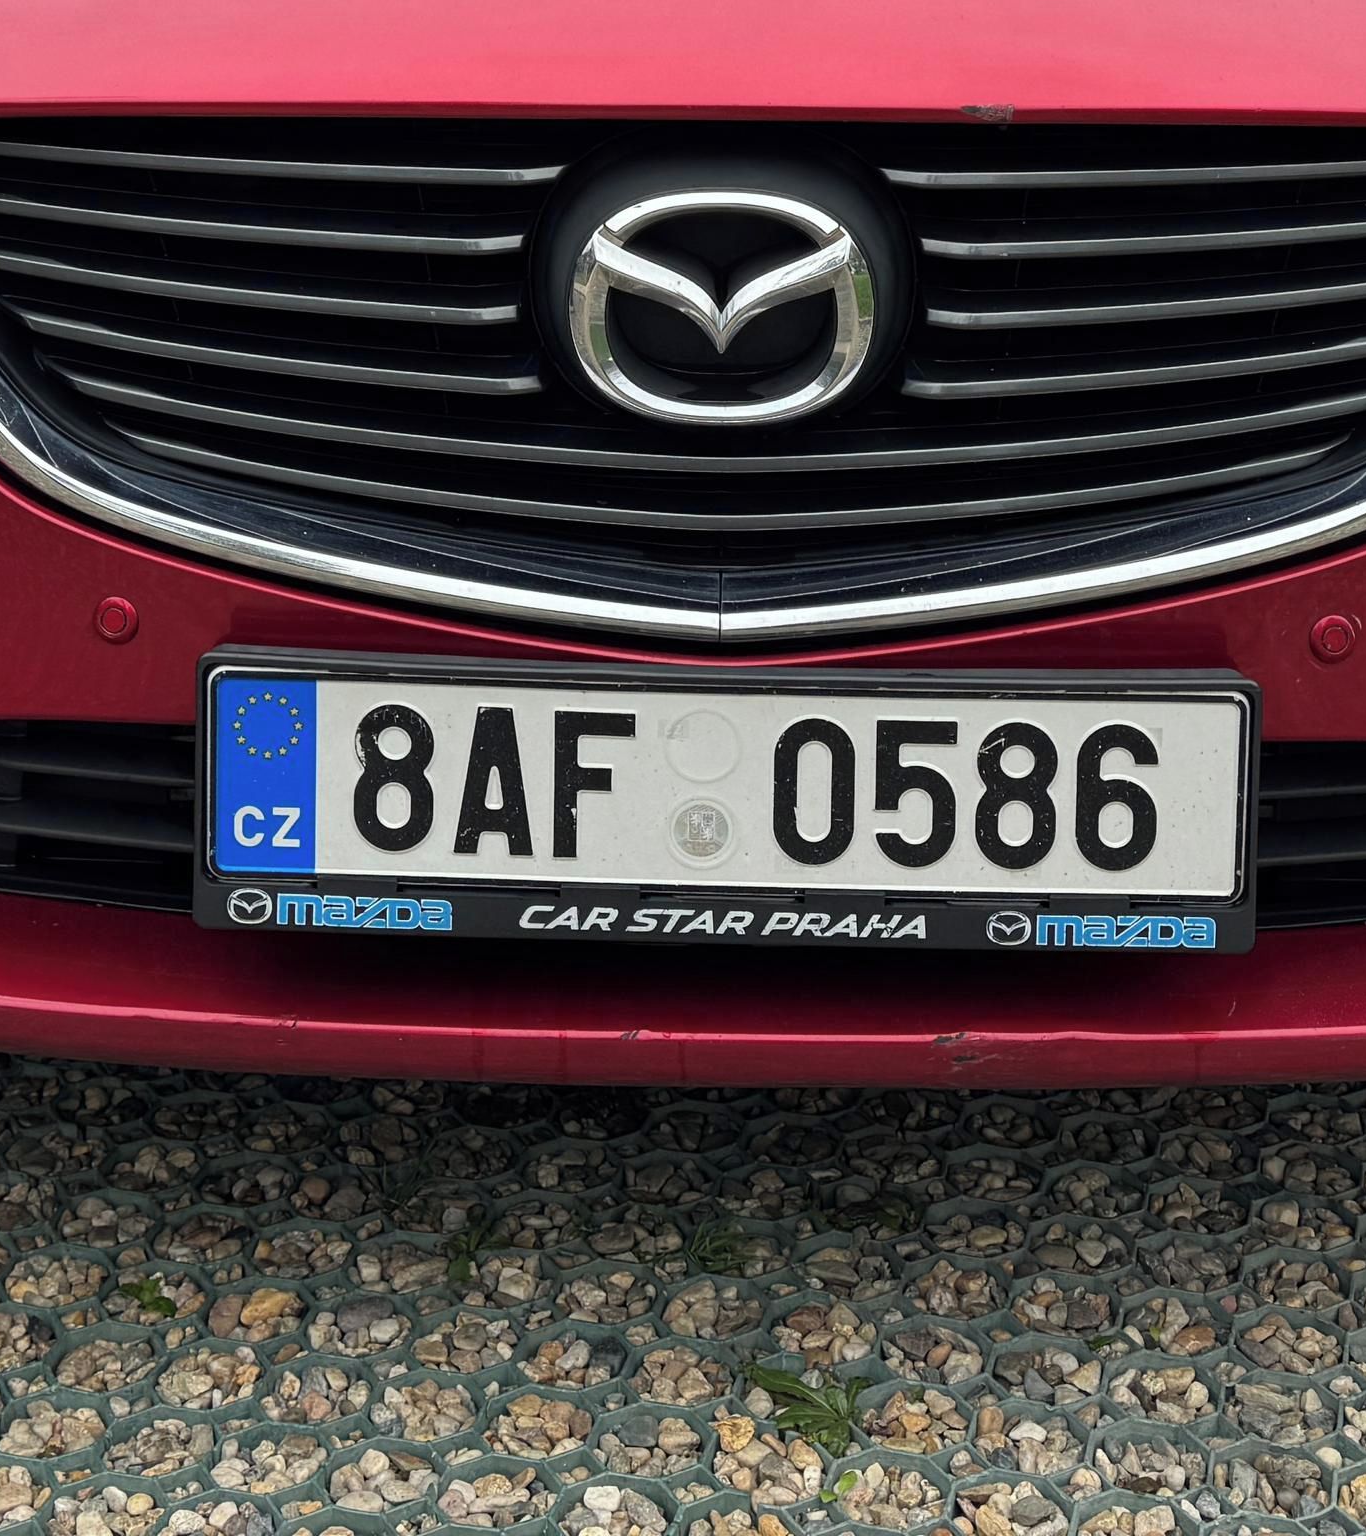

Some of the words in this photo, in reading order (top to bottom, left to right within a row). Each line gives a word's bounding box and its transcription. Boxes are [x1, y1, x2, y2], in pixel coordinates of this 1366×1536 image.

[352, 703, 636, 858] 8AF
[773, 716, 1159, 870] 0586
[233, 805, 301, 848] CZ
[519, 905, 619, 932] CAR
[625, 908, 755, 935] STAR
[760, 912, 927, 940] PRAHA
